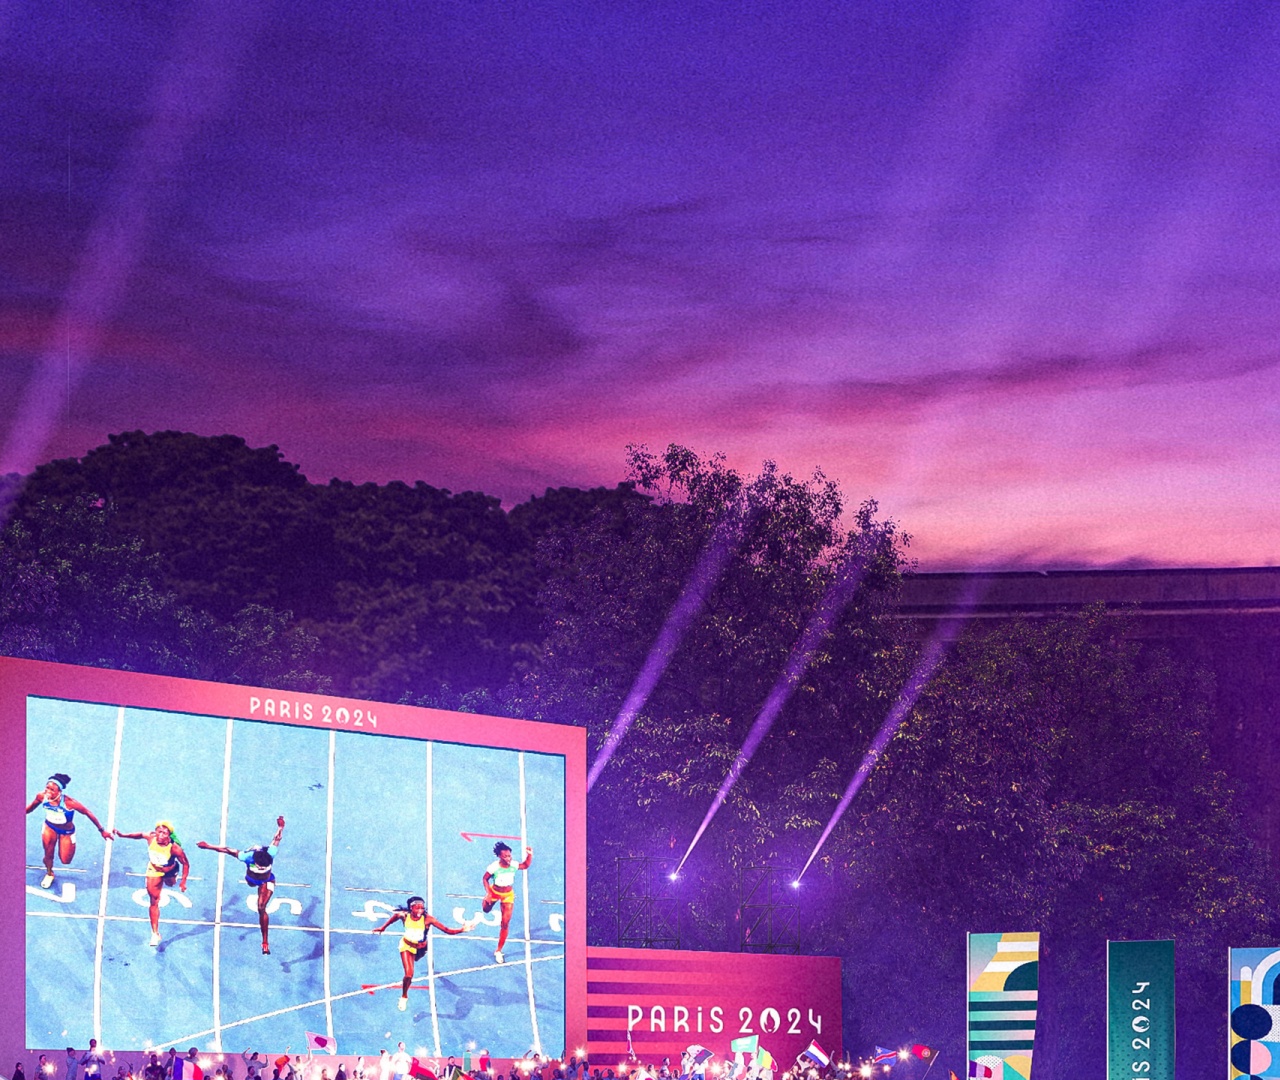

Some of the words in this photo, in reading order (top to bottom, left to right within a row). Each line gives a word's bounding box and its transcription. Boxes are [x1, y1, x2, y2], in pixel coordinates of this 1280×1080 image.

[322, 705, 377, 728] 2024
[739, 1007, 821, 1034] 2024
[1132, 982, 1150, 1049] 2024
